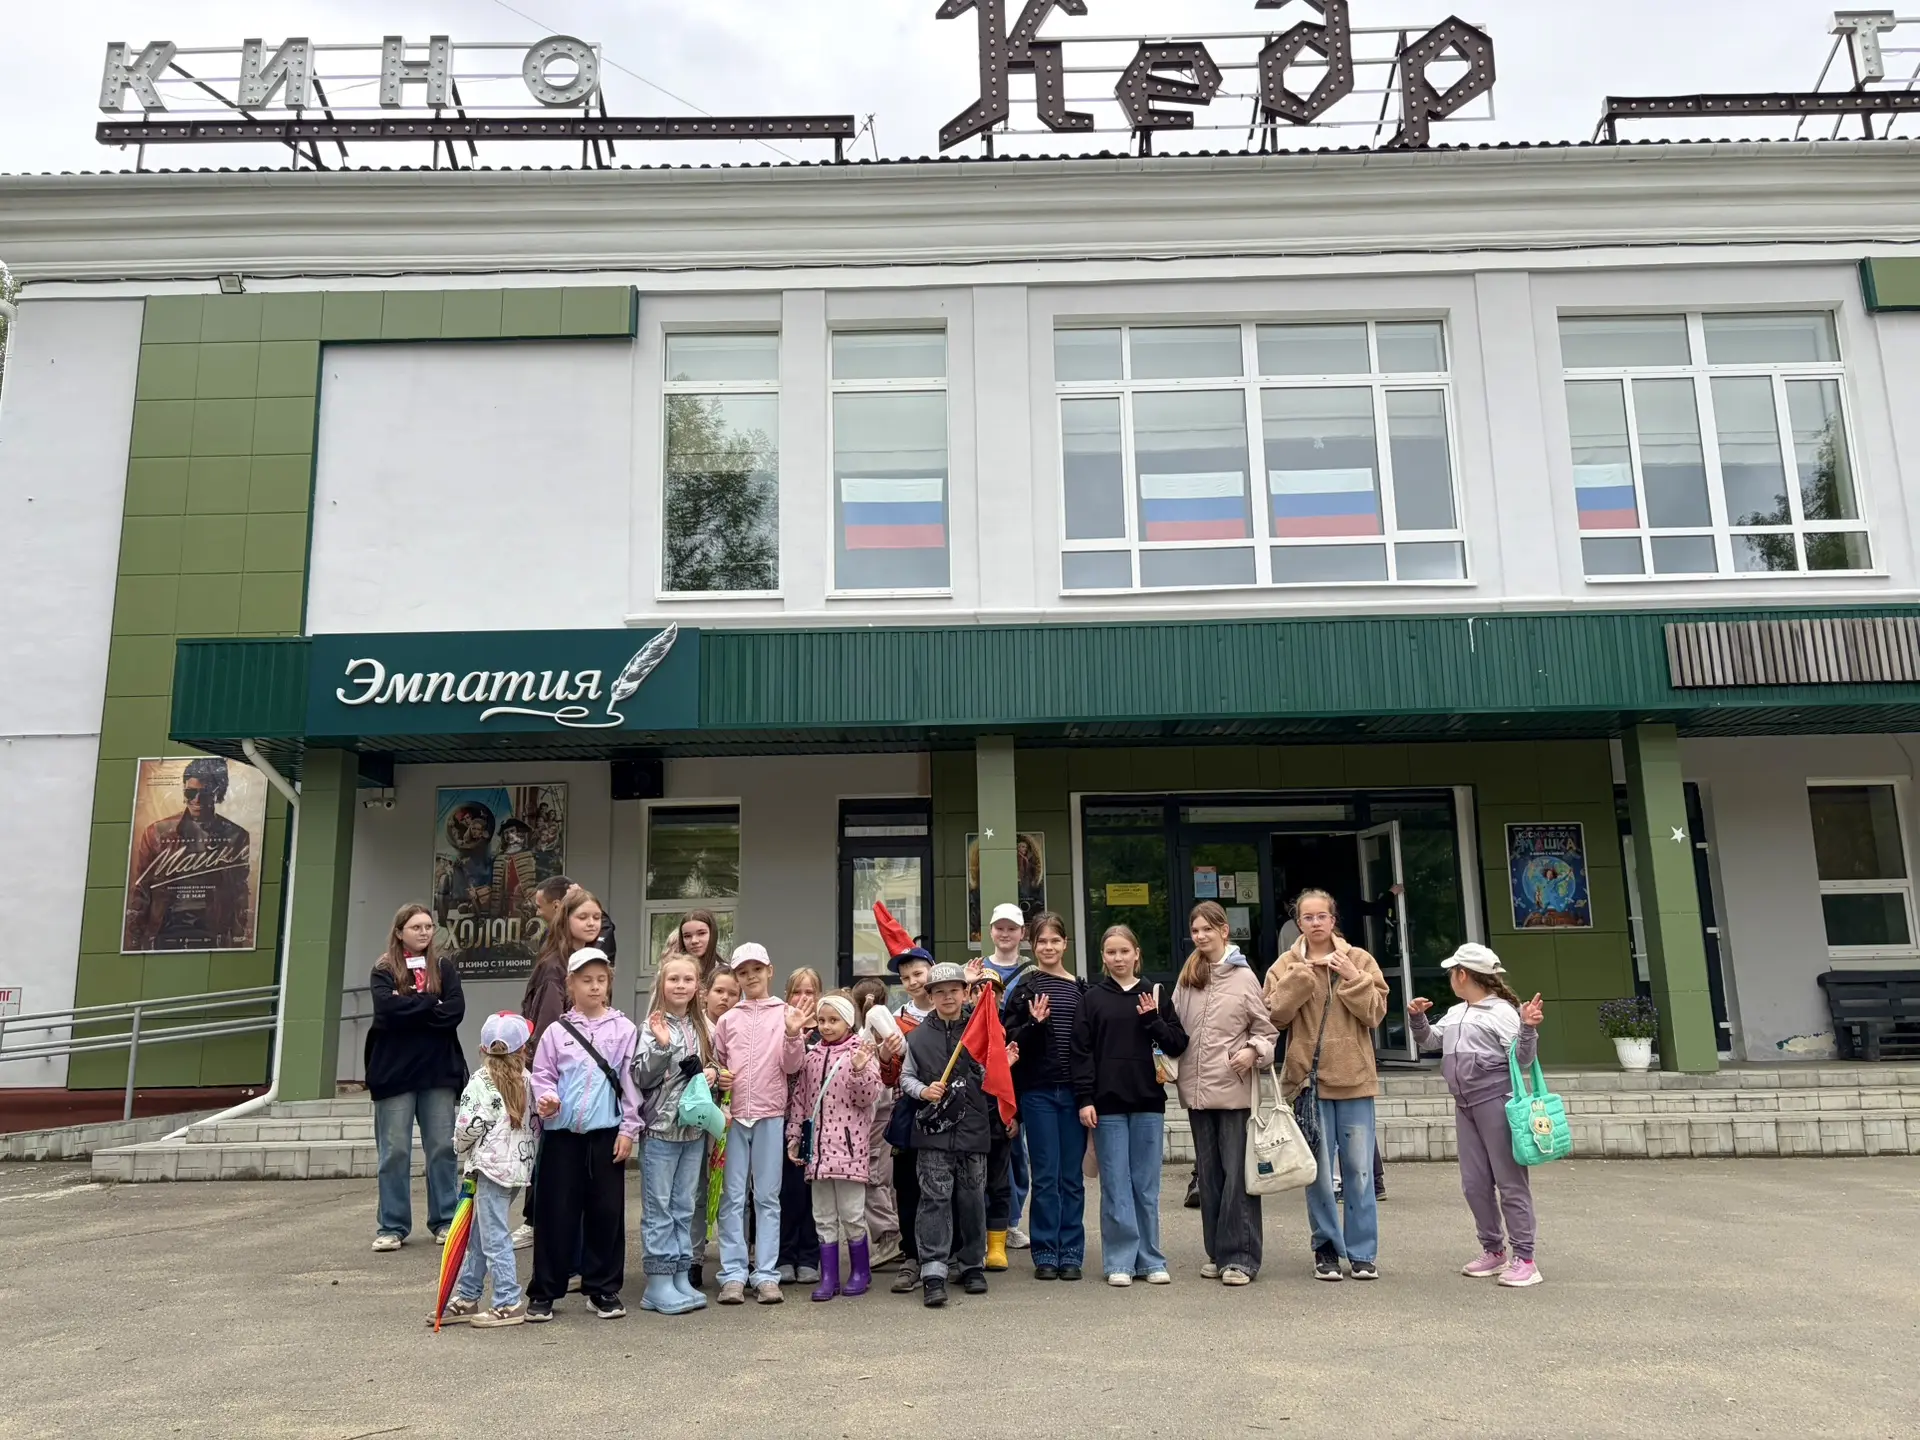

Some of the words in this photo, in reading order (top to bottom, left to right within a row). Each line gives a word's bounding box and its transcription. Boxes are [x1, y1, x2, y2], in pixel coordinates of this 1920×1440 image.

[98, 35, 598, 113] КИНО
[937, 0, 1495, 151] Кедр
[336, 658, 602, 706] Эмпатия
[135, 845, 250, 886] Майкл
[444, 917, 522, 949] ХОЛОП
[505, 959, 532, 967] ИЮНЯ
